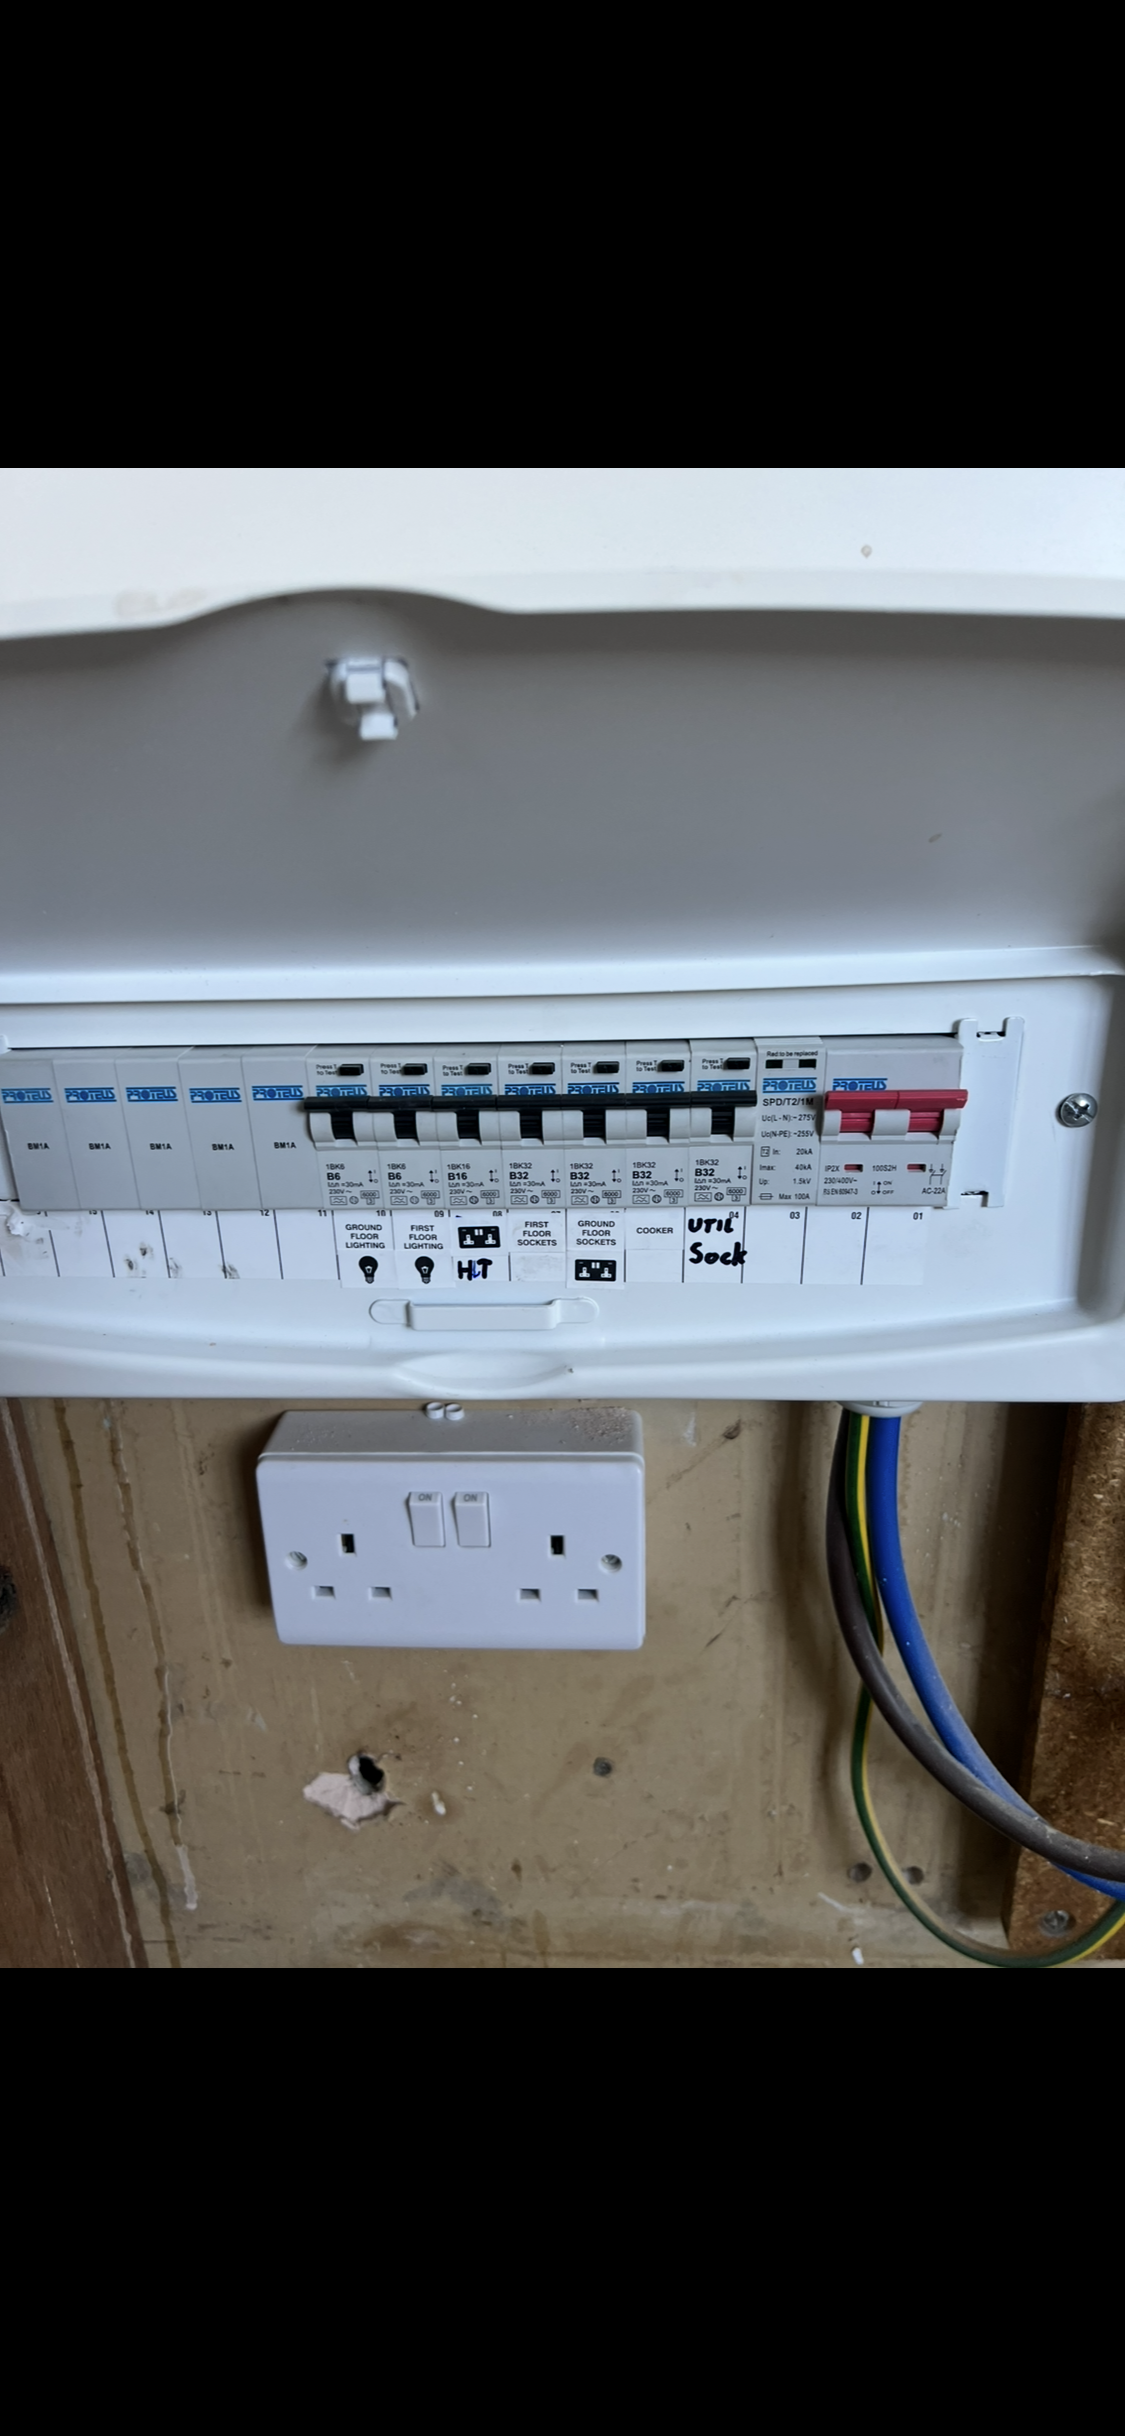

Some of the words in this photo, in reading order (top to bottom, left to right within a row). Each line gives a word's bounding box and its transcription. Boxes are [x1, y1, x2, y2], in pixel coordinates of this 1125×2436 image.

[794, 1050, 818, 1058] replaced
[567, 1085, 619, 1094] PROTEUS
[632, 1084, 685, 1093] PROTEUS
[697, 1082, 750, 1092] PROTEUS
[763, 1080, 816, 1091] PROTEUS
[832, 1081, 887, 1091] PROTEUS
[252, 1088, 303, 1099] PROTEUS
[316, 1086, 367, 1097] PROTEUS
[379, 1086, 430, 1097] PROTEUS
[441, 1086, 492, 1096] PROTEUS
[504, 1085, 556, 1095] PROTEUS
[1, 1090, 52, 1101] PROTEUS
[65, 1089, 115, 1101] PROTEUS
[126, 1089, 177, 1100] PROTEUS
[189, 1089, 241, 1101] PROTEUS
[763, 1097, 814, 1106] SPD/T2/1M
[27, 1142, 50, 1150] BM1A
[88, 1142, 111, 1150] BM1A
[149, 1142, 172, 1150] BM1A
[212, 1143, 234, 1151] BM1A
[326, 1172, 340, 1180] B6
[388, 1172, 402, 1180] B6
[448, 1172, 468, 1180] B16
[510, 1172, 529, 1180] B32
[570, 1172, 590, 1180] B32
[632, 1171, 652, 1179] B32
[695, 1168, 715, 1176] B32
[318, 1209, 328, 1217] 11
[434, 1210, 444, 1218] 09
[790, 1212, 800, 1220] 03
[851, 1212, 862, 1220] 02
[913, 1212, 923, 1220] 01
[578, 1220, 616, 1228] GROUND
[404, 1242, 444, 1250] LIGHTING
[576, 1238, 616, 1246] SOCKETS
[689, 1242, 748, 1267] Sock
[418, 1493, 432, 1502] ON
[464, 1493, 478, 1502] ON
